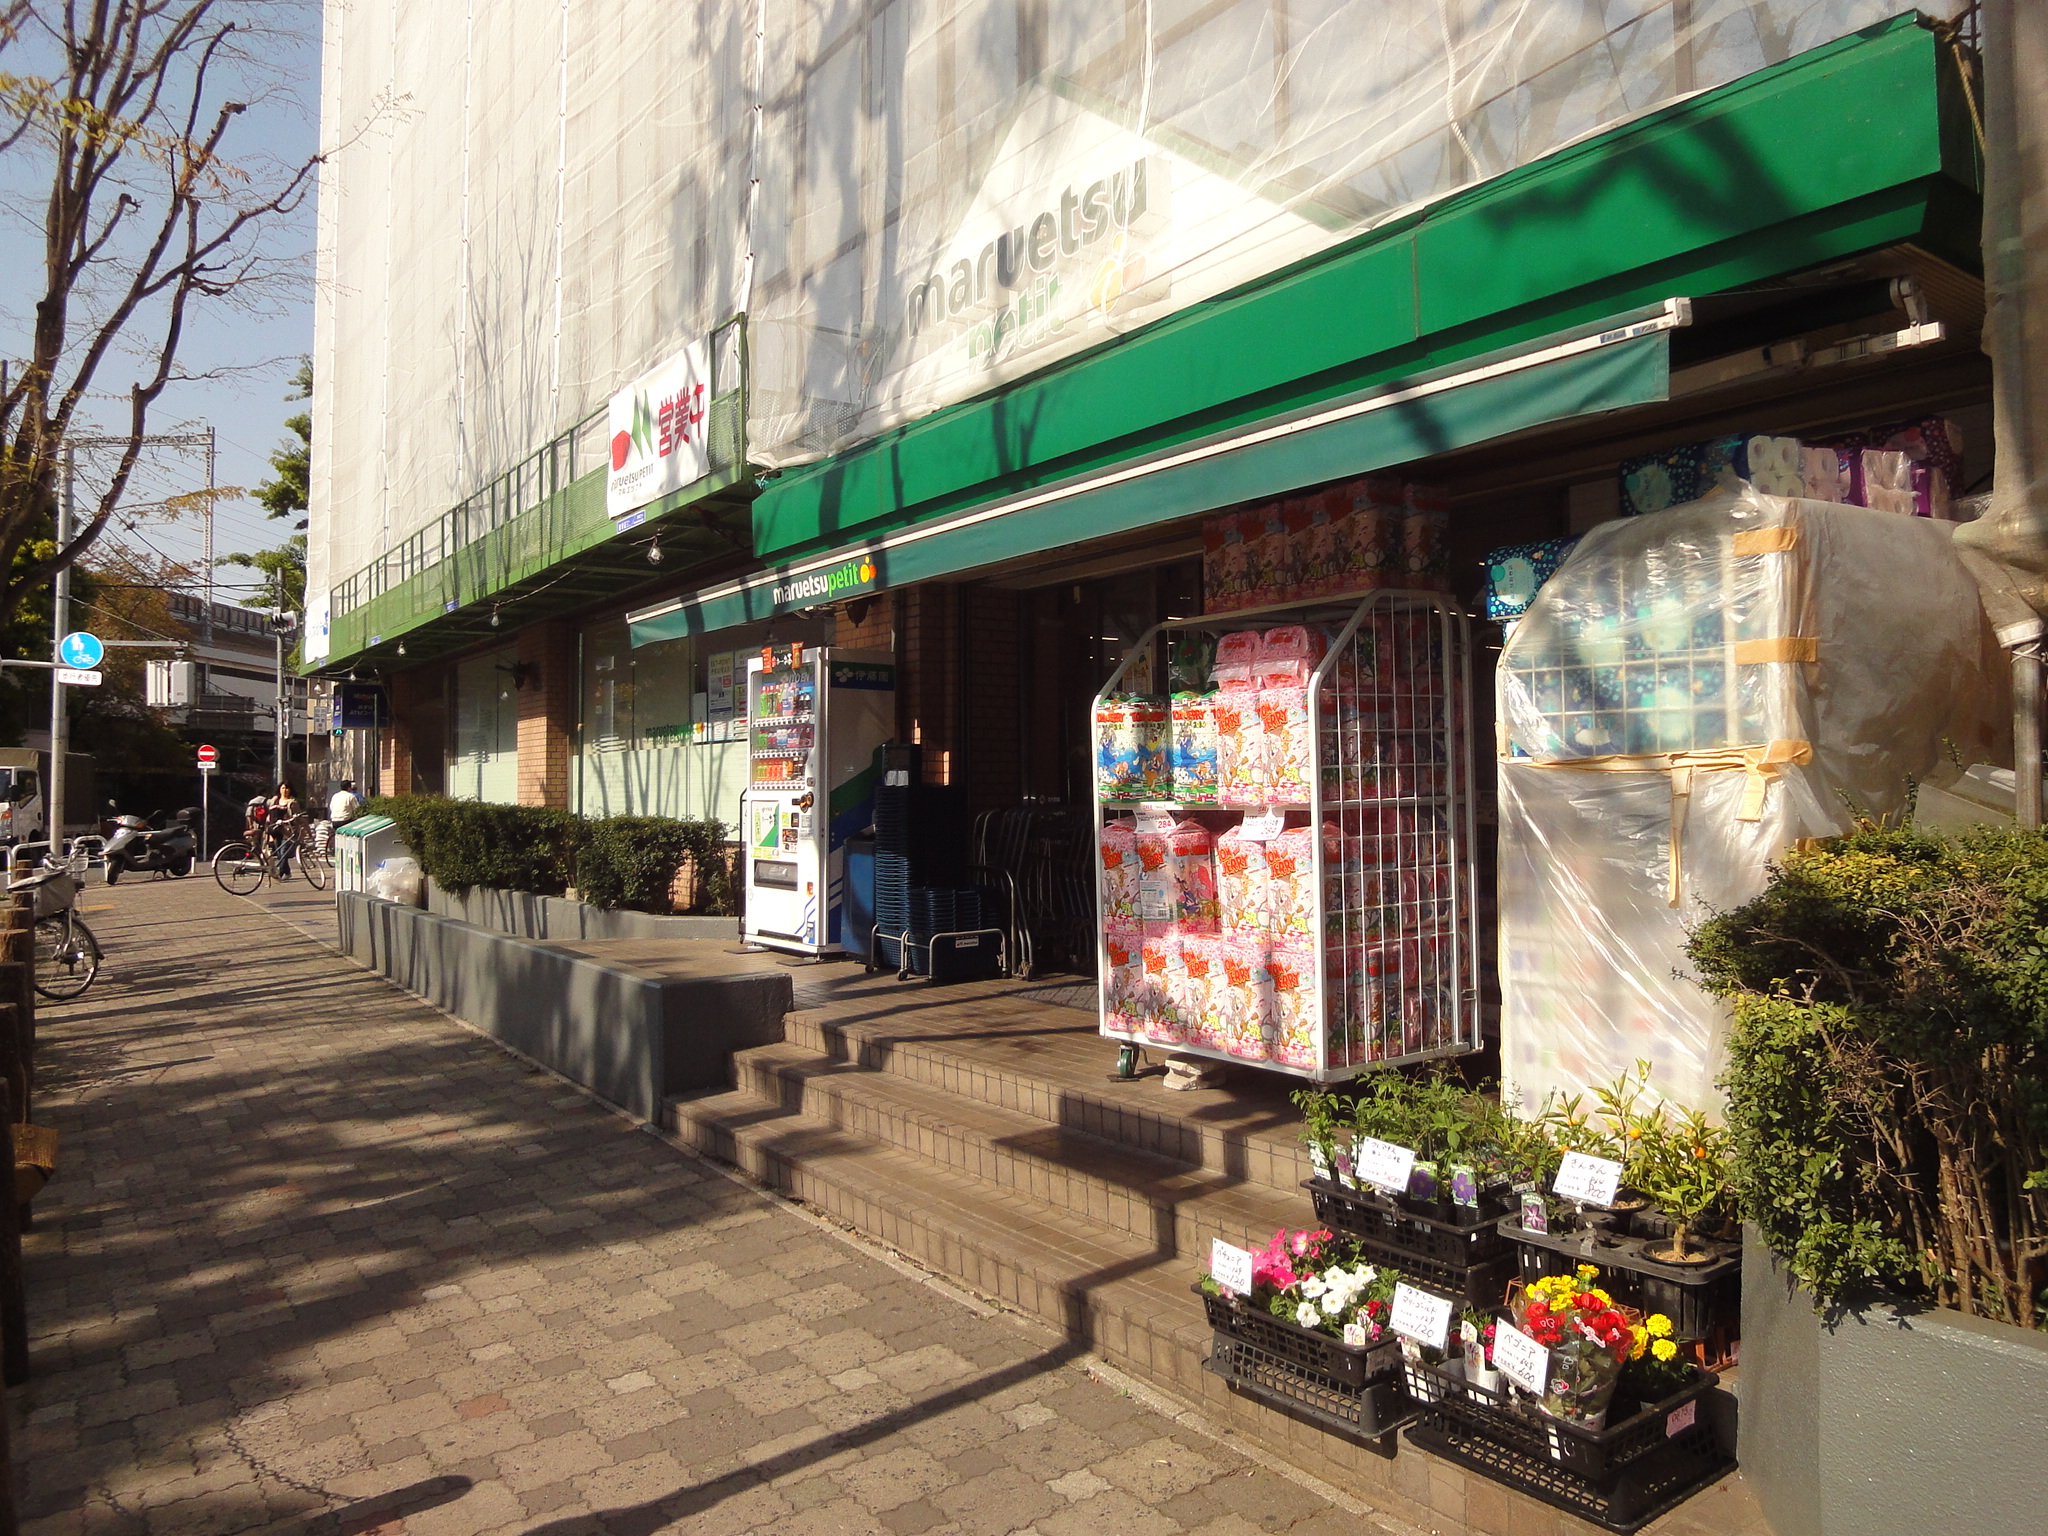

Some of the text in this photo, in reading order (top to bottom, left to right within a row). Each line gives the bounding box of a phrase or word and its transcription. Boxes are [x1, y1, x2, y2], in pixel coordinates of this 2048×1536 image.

[907, 157, 1148, 339] maruetsu
[969, 272, 1067, 375] petit
[658, 380, 705, 458] 営業中
[1222, 854, 1248, 877] JERRY
[1270, 858, 1297, 881] JERRY
[1571, 1159, 1607, 1175] きんかん
[1414, 1324, 1435, 1338] 120
[1504, 1334, 1536, 1359] ベゴニア
[1518, 1367, 1535, 1383] 600
